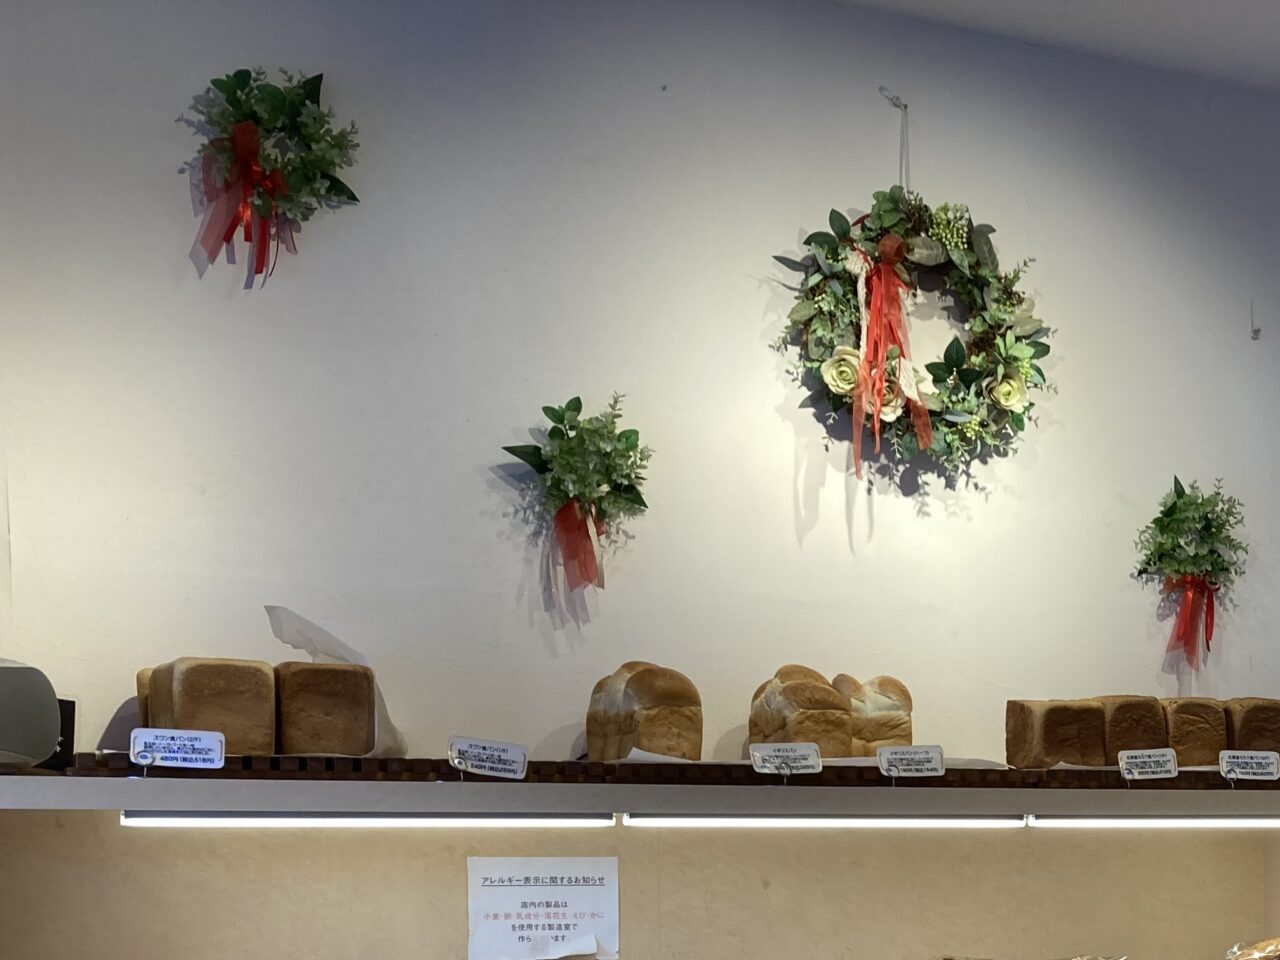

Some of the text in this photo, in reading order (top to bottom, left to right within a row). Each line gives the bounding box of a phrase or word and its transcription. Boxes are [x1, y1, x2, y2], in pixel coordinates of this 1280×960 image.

[481, 876, 605, 885] アレルギー表示に関するお知らせ
[520, 901, 568, 909] 店内の製品は
